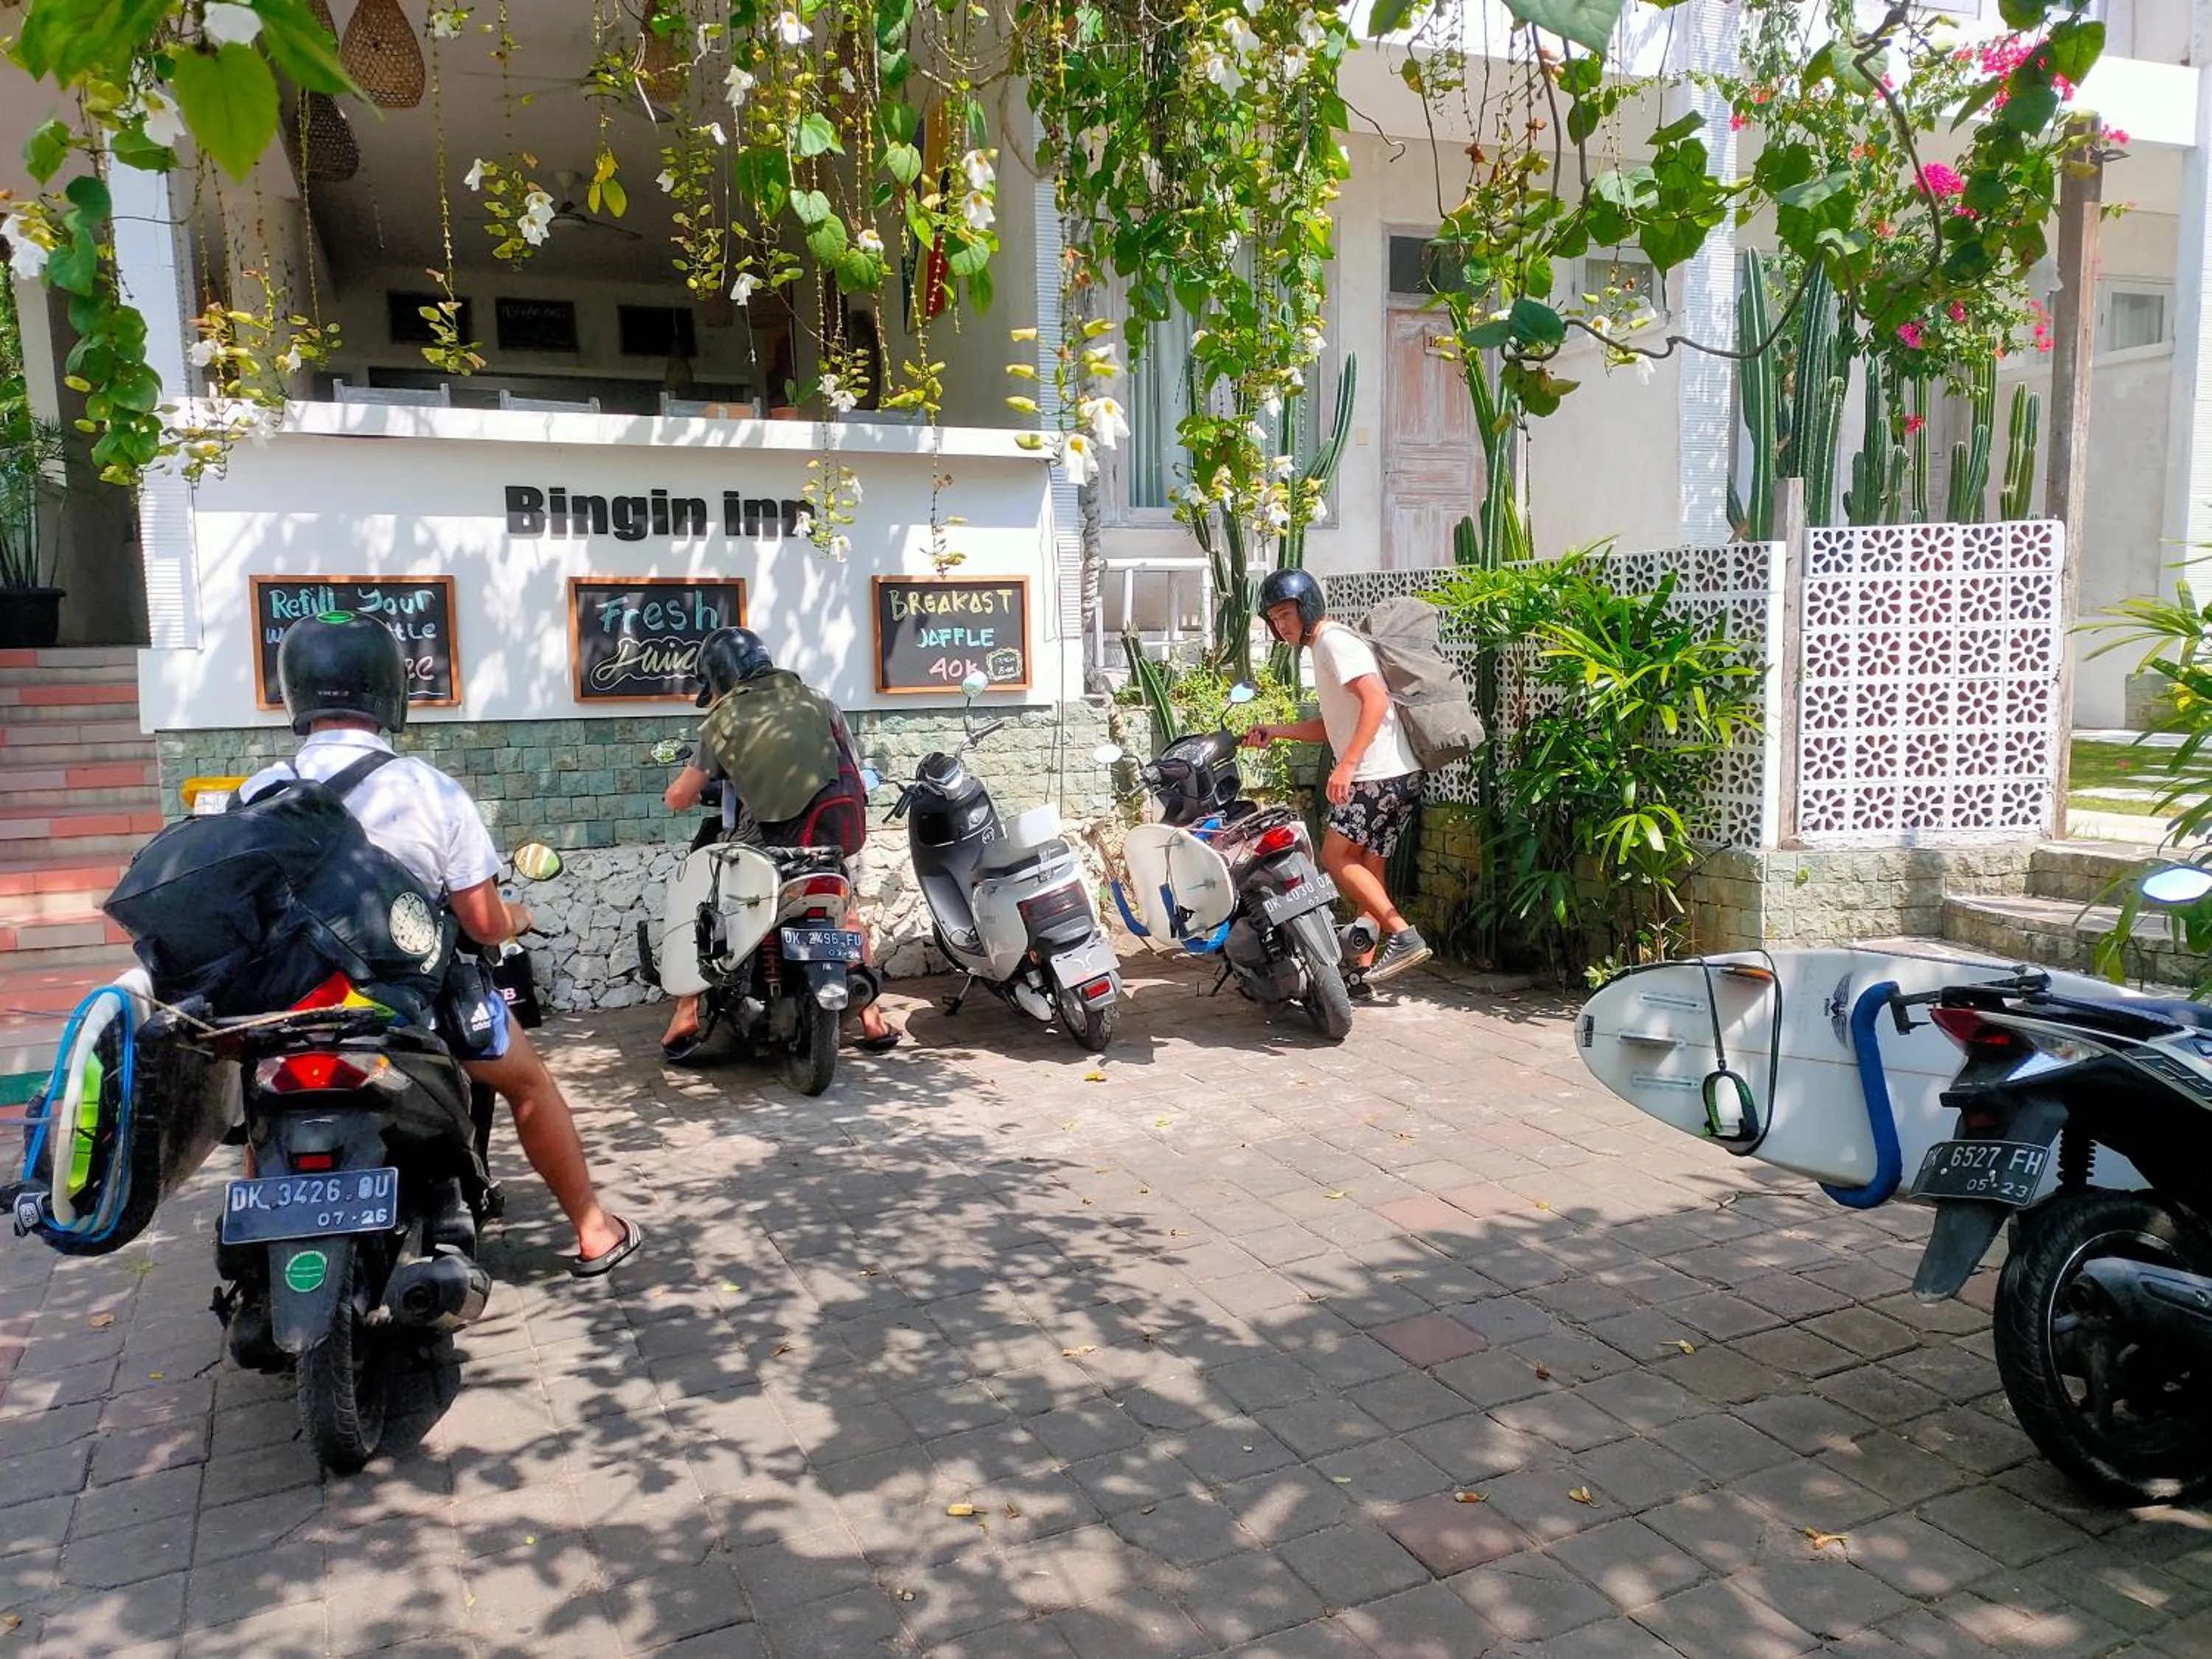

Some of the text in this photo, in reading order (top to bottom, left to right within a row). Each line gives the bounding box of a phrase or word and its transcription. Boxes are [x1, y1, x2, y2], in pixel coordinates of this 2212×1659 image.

[504, 485, 815, 542] Bingin inn
[268, 585, 335, 619] Refill
[595, 589, 719, 634] Fresh
[887, 589, 1013, 622] BREAKAST
[917, 627, 995, 649] JAFFLE
[595, 641, 698, 681] Juic
[784, 931, 800, 945] DK
[1950, 1146, 2002, 1168] 6527
[2007, 1148, 2043, 1176] FH
[231, 1184, 271, 1211] DK
[277, 1178, 341, 1206] 3426
